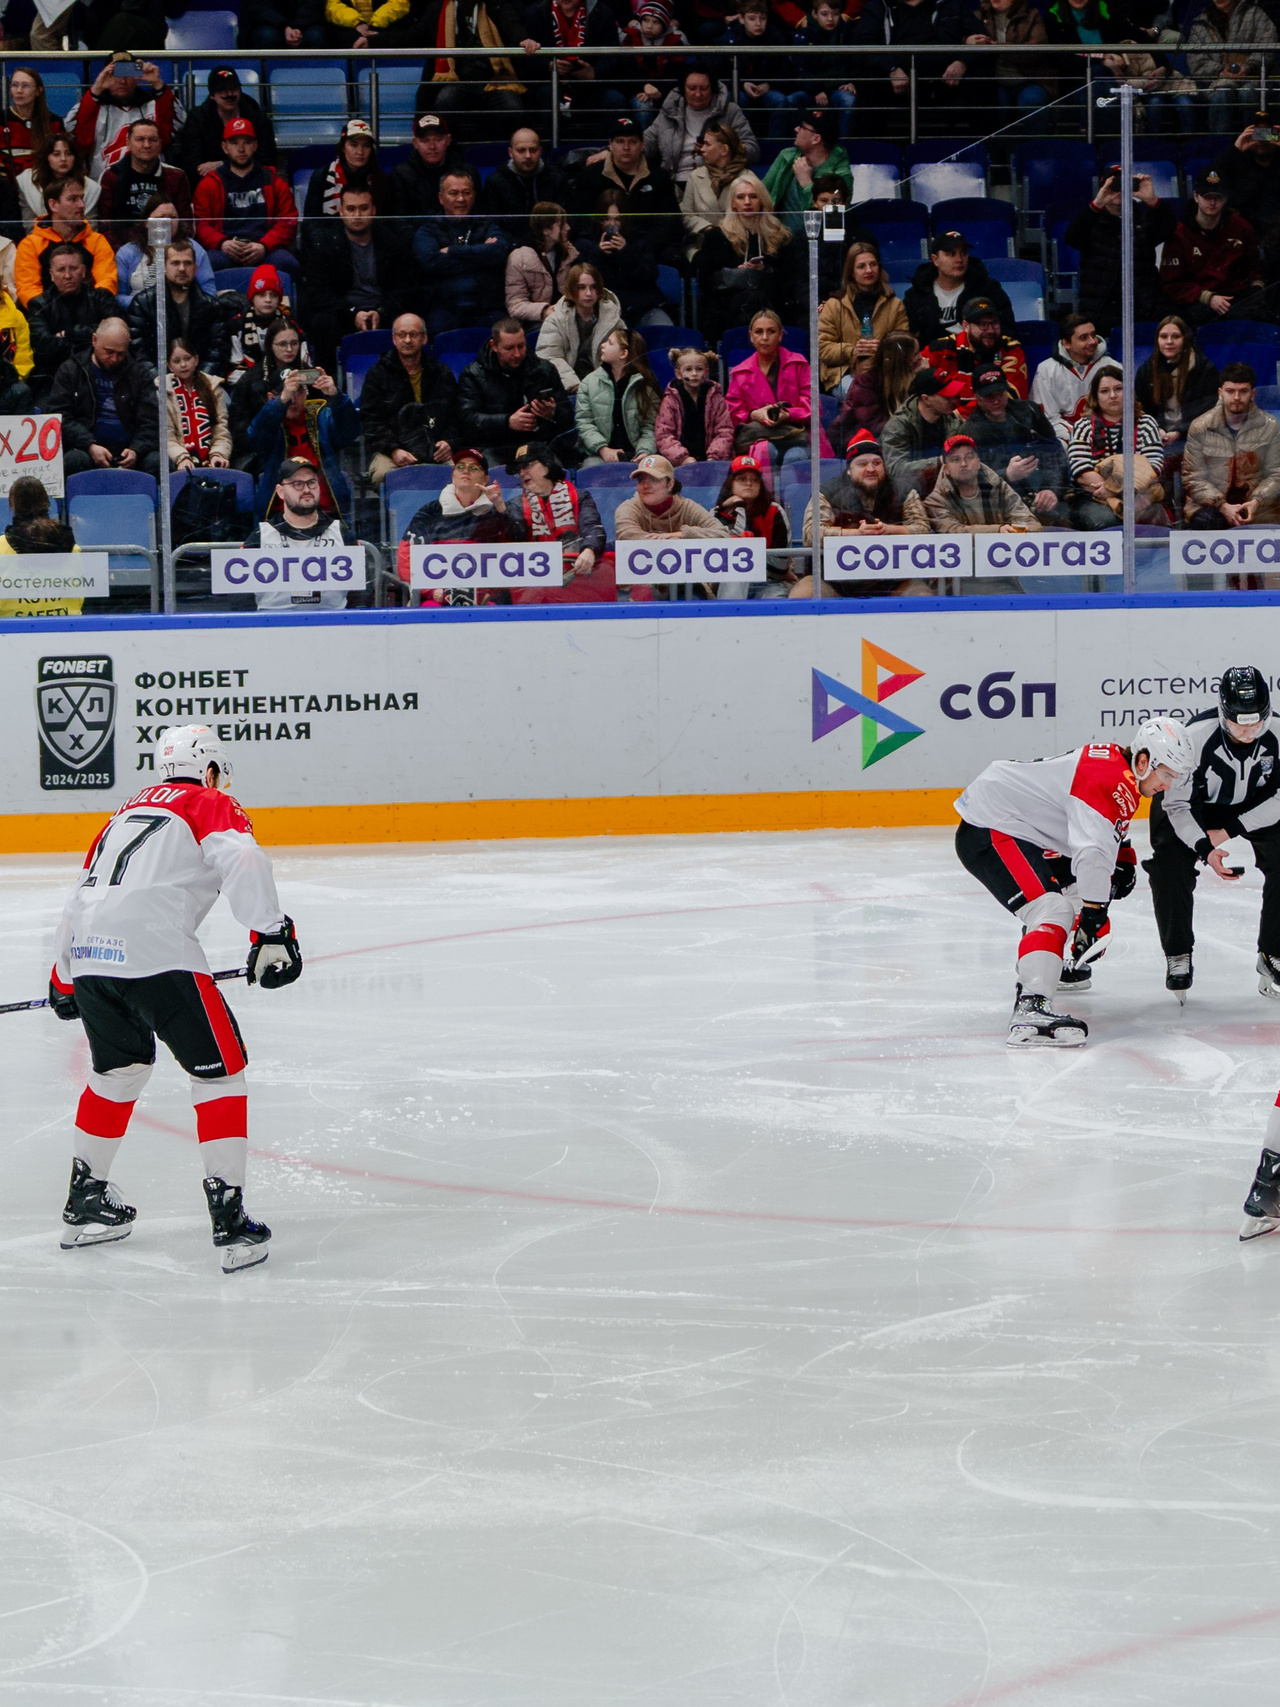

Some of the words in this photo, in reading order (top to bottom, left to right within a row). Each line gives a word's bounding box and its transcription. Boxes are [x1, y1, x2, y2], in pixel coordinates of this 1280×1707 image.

[940, 306, 957, 320] NIK
[43, 660, 107, 674] FONBET
[135, 670, 249, 689] ФОНБЕТ
[1101, 677, 1222, 697] система
[136, 692, 419, 716] КОНТИНЕНТАЛЬНАЯ
[136, 719, 311, 744] ХОЕЙНАЯ
[45, 773, 109, 785] 2024/2025
[81, 814, 171, 887] 17
[106, 939, 124, 947] АЗС
[194, 1062, 222, 1071] BAUER
